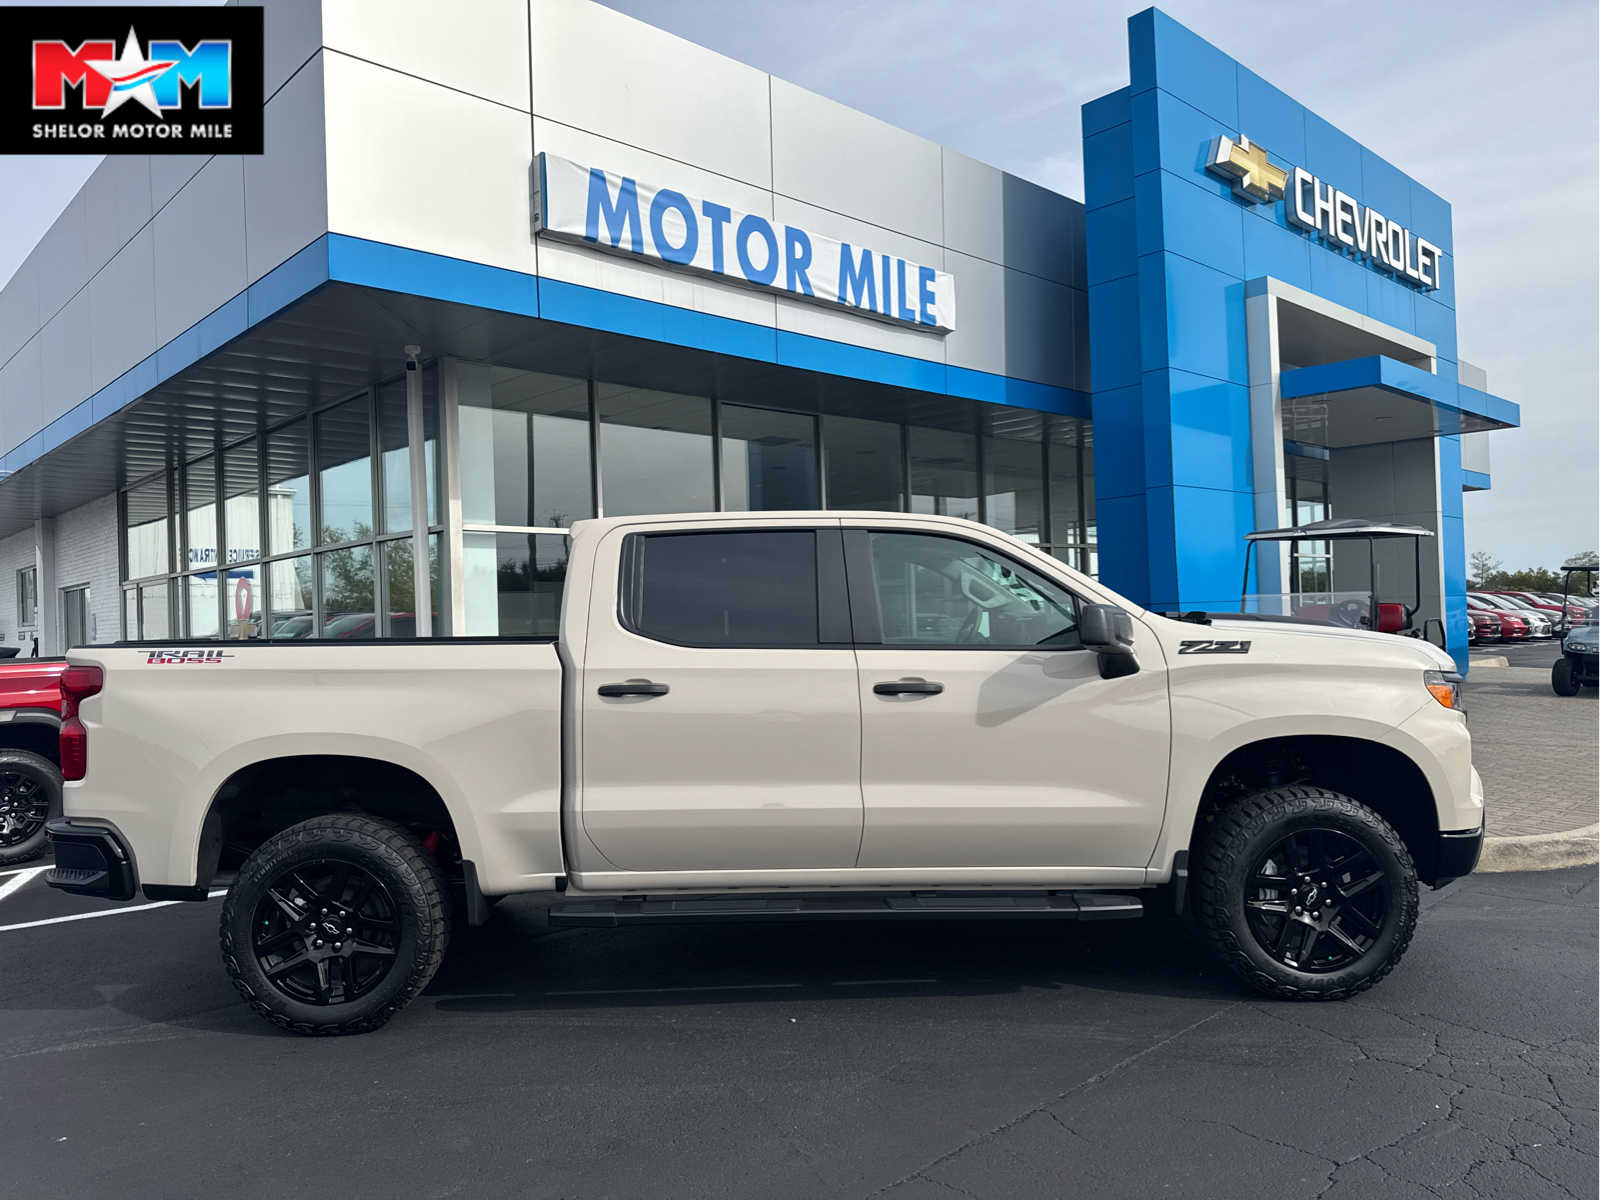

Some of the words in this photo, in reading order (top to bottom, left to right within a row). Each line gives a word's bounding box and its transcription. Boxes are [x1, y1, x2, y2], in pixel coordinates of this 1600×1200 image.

[585, 167, 815, 296] MOTOR
[837, 242, 937, 326] MILE
[1294, 166, 1443, 290] CHEVROLET
[137, 650, 235, 658] TRAIL
[1178, 640, 1251, 654] Z71
